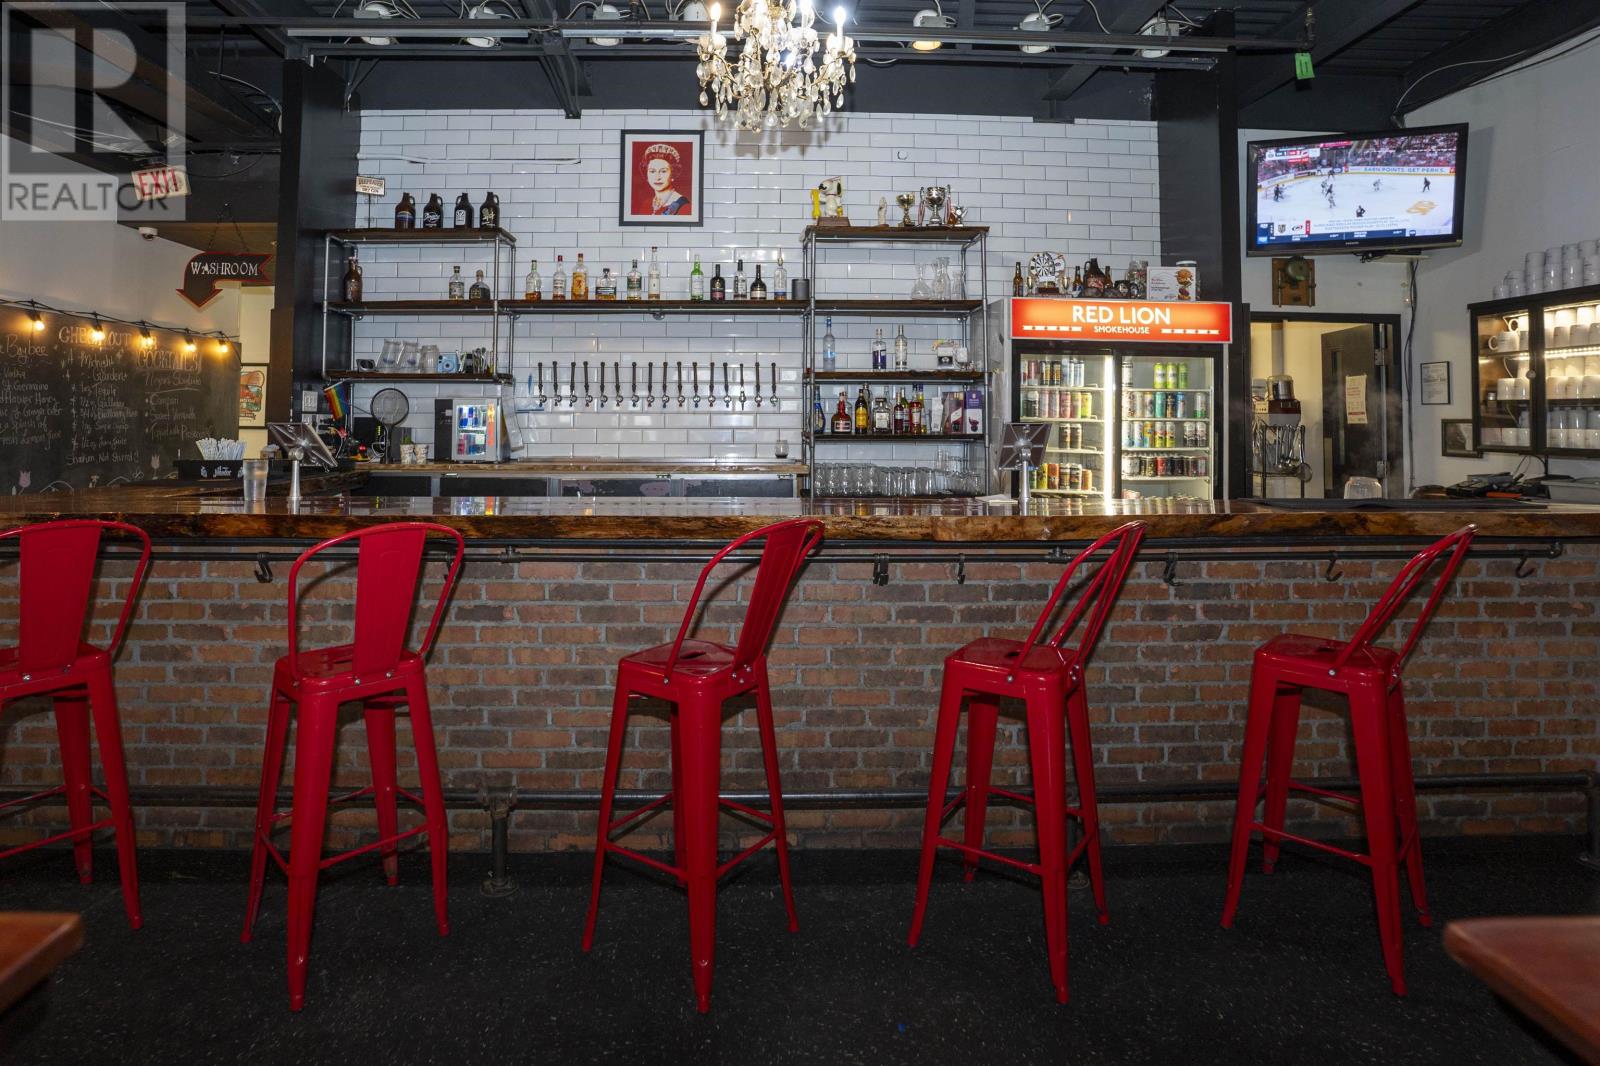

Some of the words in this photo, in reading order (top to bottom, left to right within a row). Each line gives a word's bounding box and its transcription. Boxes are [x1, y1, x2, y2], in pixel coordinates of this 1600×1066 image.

[138, 168, 179, 197] EXIT
[191, 261, 258, 275] WASHROOM
[1072, 305, 1114, 324] RED
[1120, 306, 1171, 325] LION
[1093, 325, 1150, 334] SMOKEHOUSE
[108, 331, 131, 346] OUT
